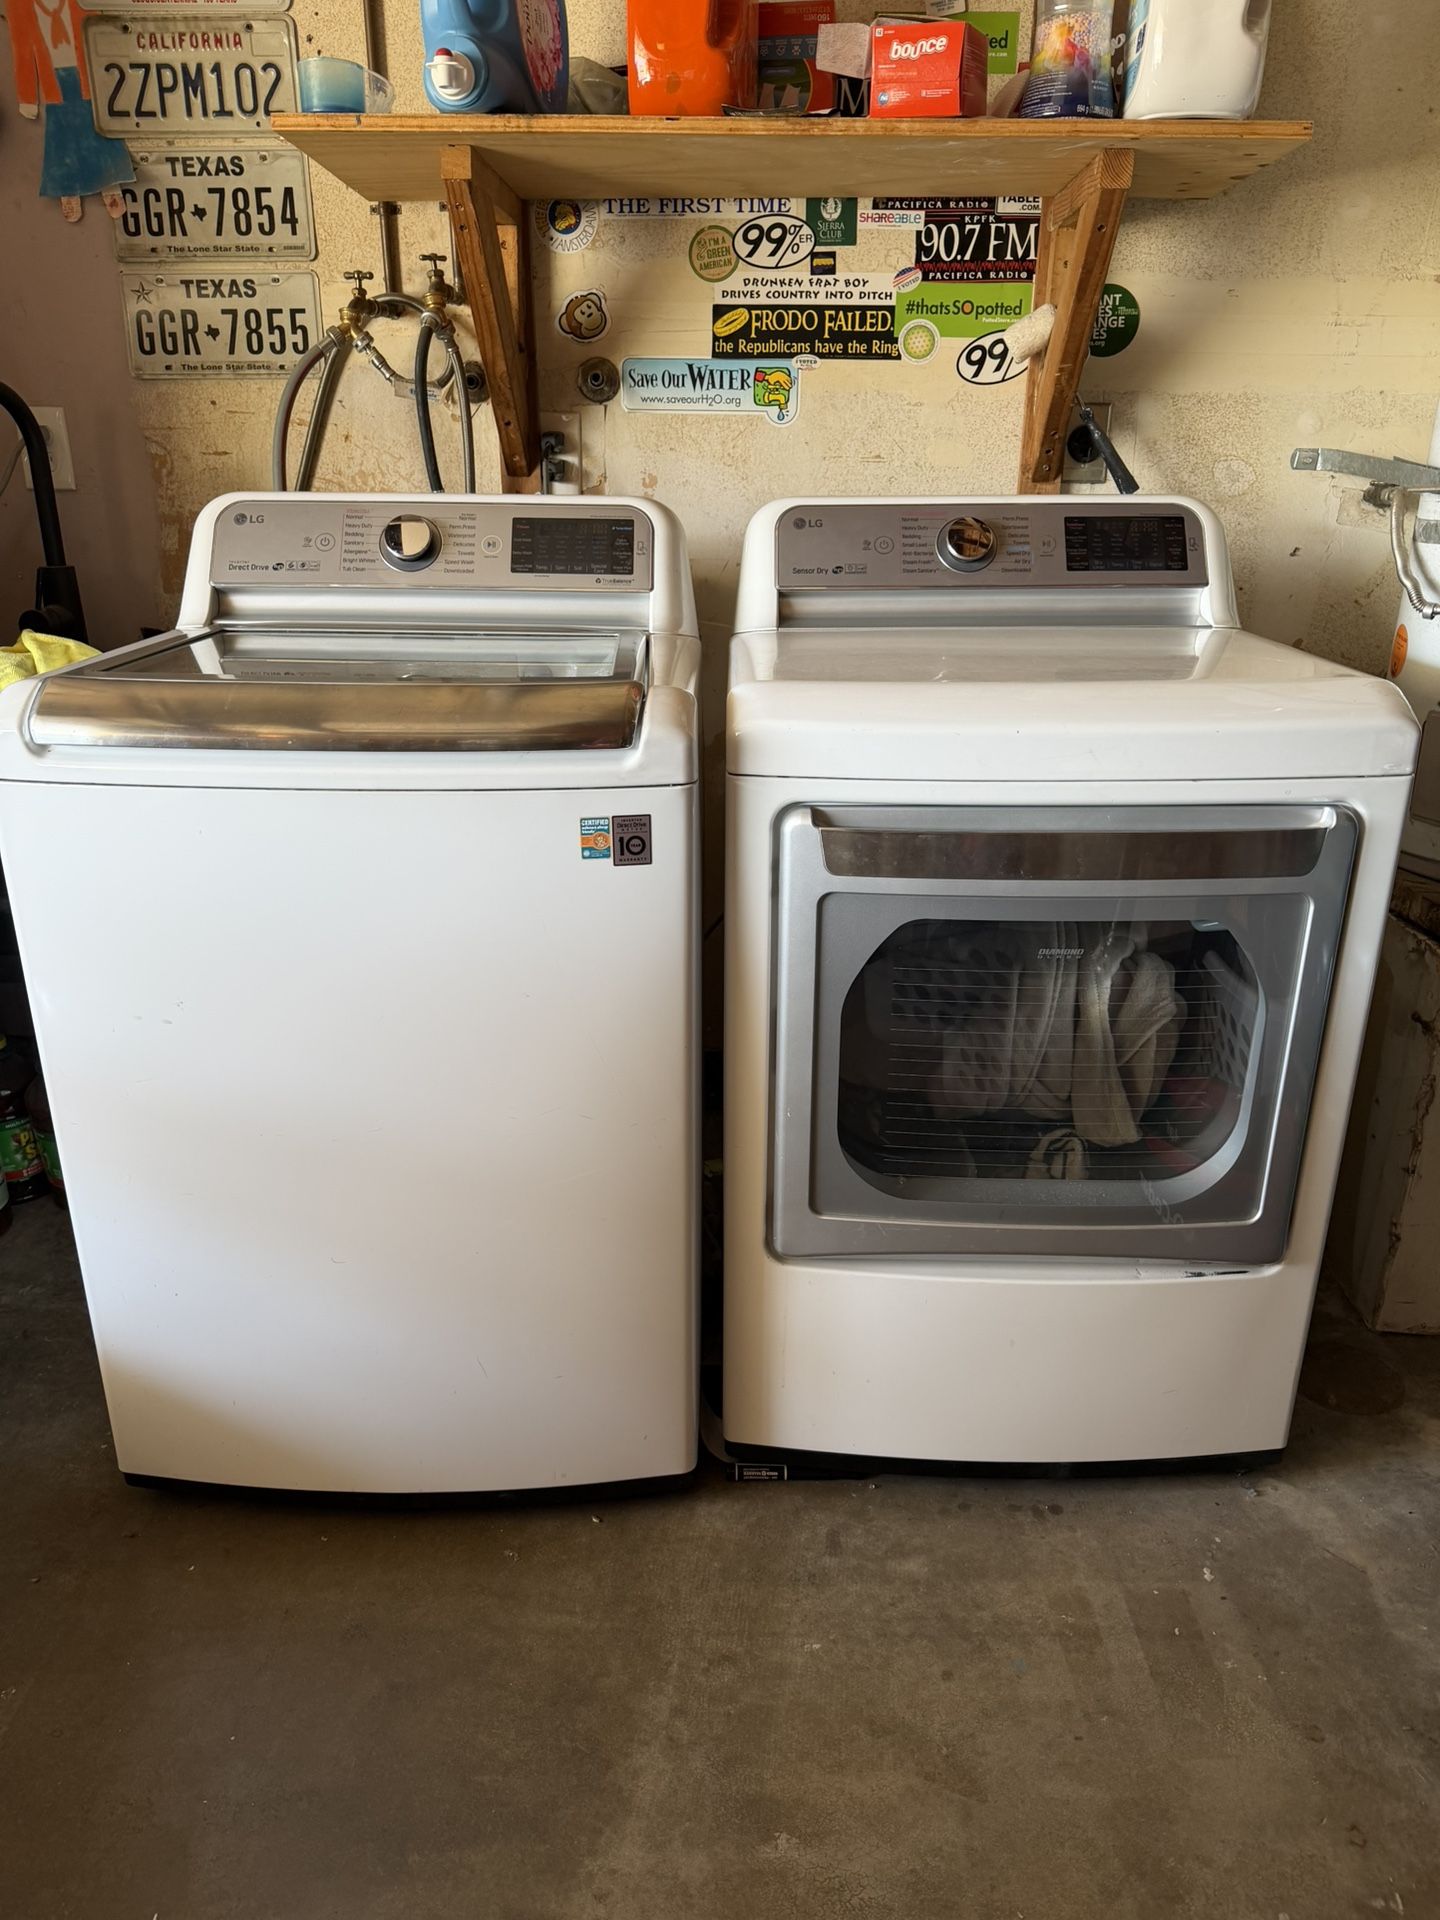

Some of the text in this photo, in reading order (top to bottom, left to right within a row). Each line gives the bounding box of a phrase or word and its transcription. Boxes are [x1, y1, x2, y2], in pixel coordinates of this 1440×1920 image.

[136, 31, 242, 50] CALIFORNIA
[890, 35, 948, 60] bounce
[104, 61, 285, 118] 2ZPM102
[165, 155, 245, 178] TEXAS
[121, 186, 299, 237] GGR 7854
[603, 197, 791, 214] THE FIRST TIME
[888, 201, 943, 209] PACIFICA
[817, 220, 845, 231] SIERRA
[964, 215, 997, 223] KPFK
[820, 230, 842, 239] CLUB
[166, 245, 260, 253] The Lone Star State
[921, 223, 1038, 262] 90.7 FM
[707, 246, 731, 259] GREEN
[699, 258, 733, 271] AMERICAN
[928, 272, 983, 280] PACIFICA
[180, 279, 257, 299] TEXAS
[743, 278, 869, 288] DRUNKEN FRAT BOY
[722, 290, 893, 300] DRIVES COUNTRY INTO DITCH
[905, 298, 1023, 320] #thatsSOpotted
[750, 309, 894, 338] FRODO FAILED.
[136, 308, 310, 356] GGR 7855
[715, 339, 899, 356] the Republicans have the Ring
[181, 363, 271, 371] The Lone Star State
[628, 362, 752, 393] Save Our WATER
[640, 393, 741, 408] www.saveourH2O.org
[249, 514, 265, 524] LG
[808, 519, 823, 528] LG
[228, 563, 270, 571] Direct Drive
[792, 567, 829, 575] Sensor Dry
